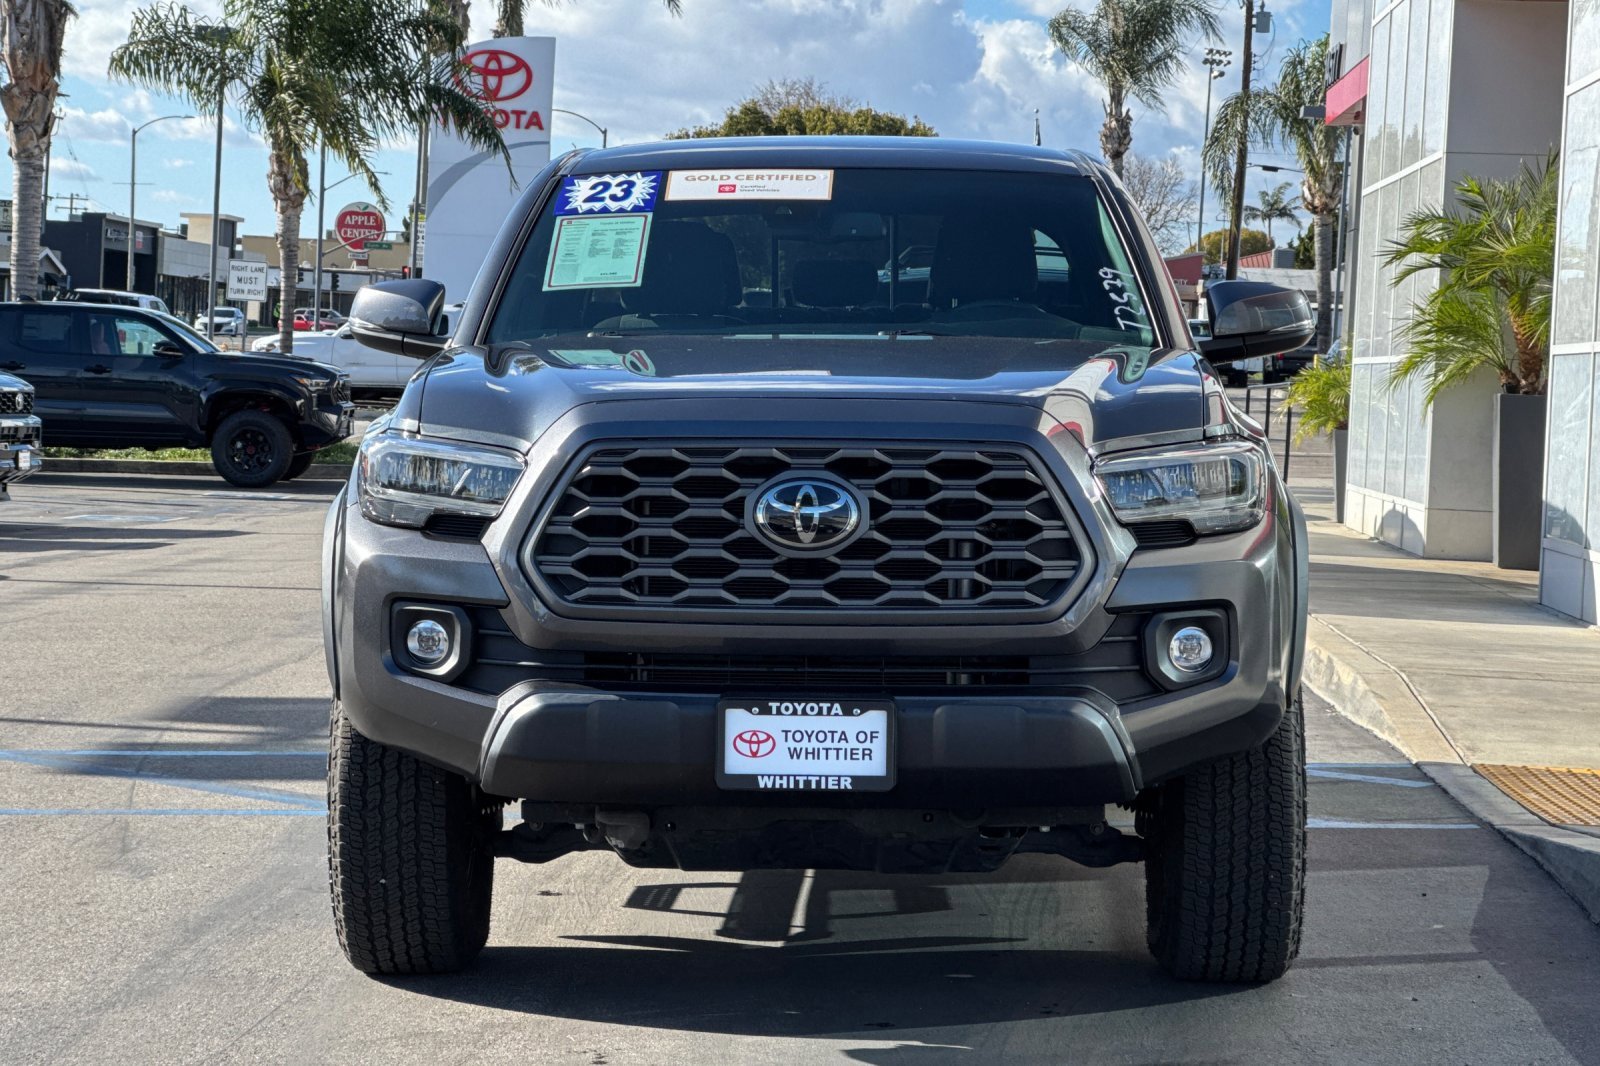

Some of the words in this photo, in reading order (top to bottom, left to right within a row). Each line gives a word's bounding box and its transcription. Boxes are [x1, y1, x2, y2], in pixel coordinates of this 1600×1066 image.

[684, 174, 731, 182] GOLD
[582, 179, 637, 204] 23
[344, 215, 376, 226] APPLE
[340, 228, 378, 239] CENTER
[231, 264, 248, 272] RIGHT
[236, 276, 258, 285] MUST
[230, 287, 245, 295] TURN
[247, 288, 264, 296] RIGHT
[768, 702, 843, 716] TOYOTA
[781, 730, 849, 744] TOYOTA
[855, 730, 880, 744] OF
[787, 747, 873, 761] WHITTIER
[757, 775, 853, 790] WHITTIER
